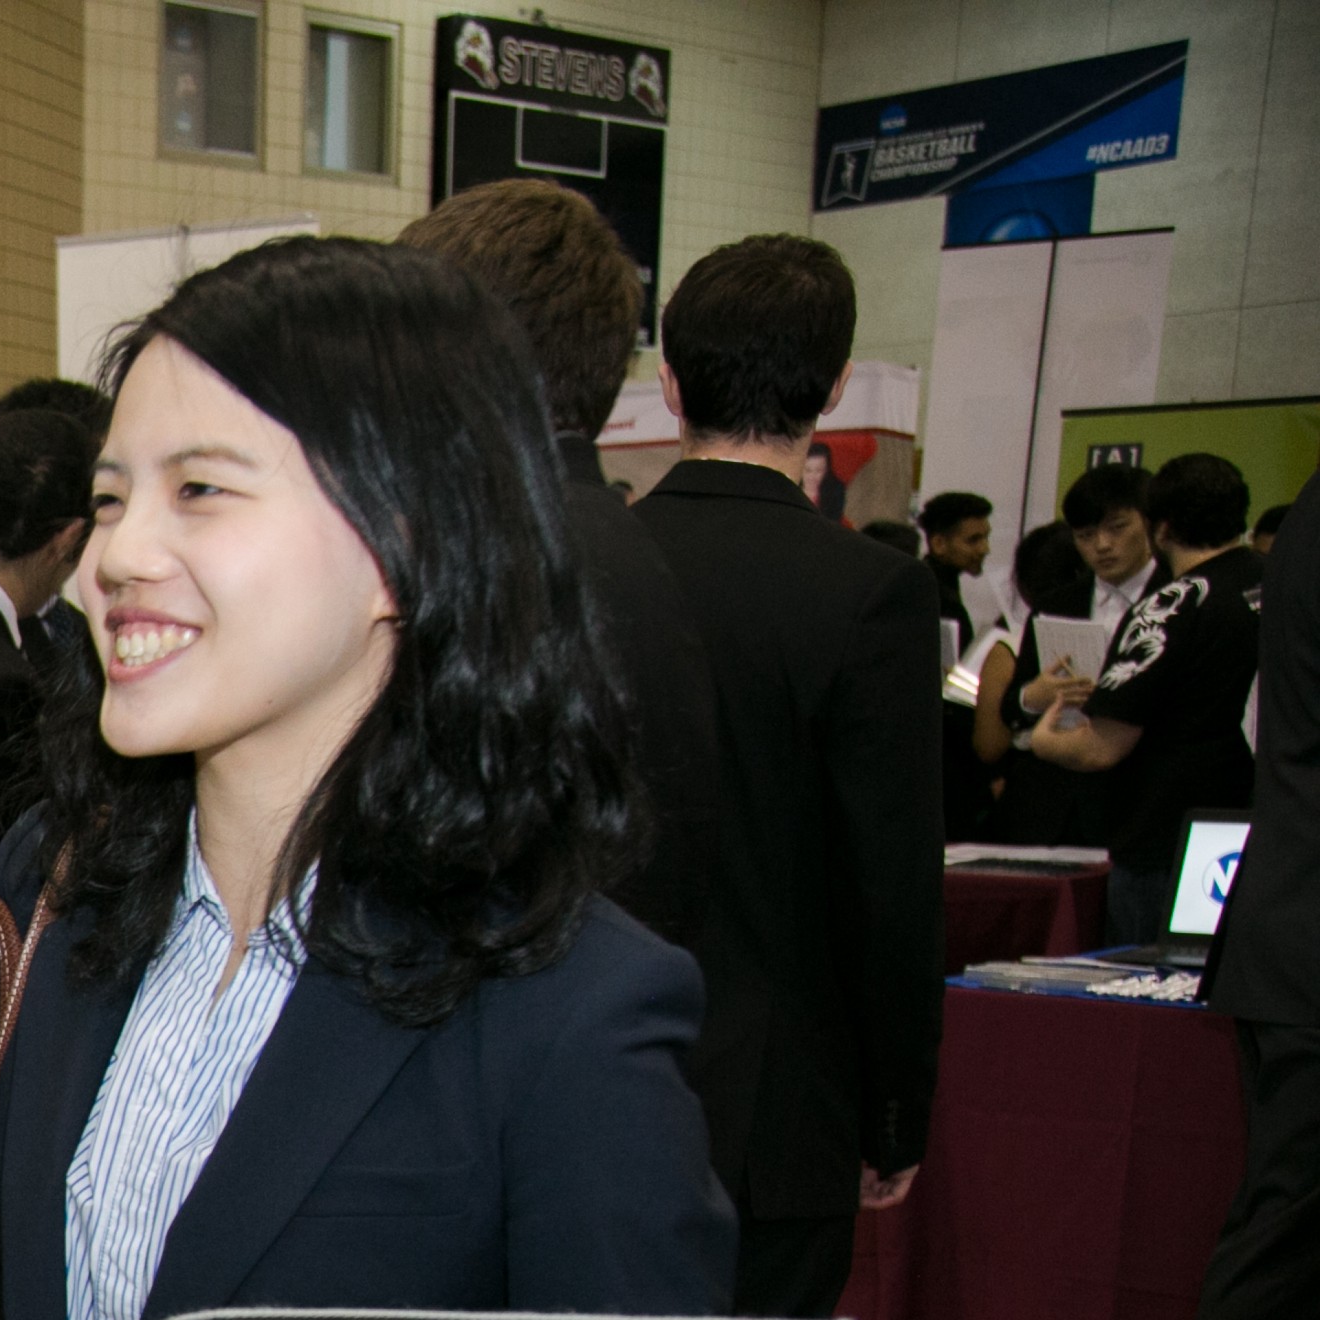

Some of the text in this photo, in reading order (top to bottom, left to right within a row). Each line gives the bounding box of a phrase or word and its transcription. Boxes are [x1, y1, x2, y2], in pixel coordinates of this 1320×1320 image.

[499, 36, 625, 101] STEVENS
[875, 132, 976, 168] BASKETBALL
[1086, 134, 1170, 164] #NCAAD3
[870, 155, 958, 181] CHAMPIONSHIP
